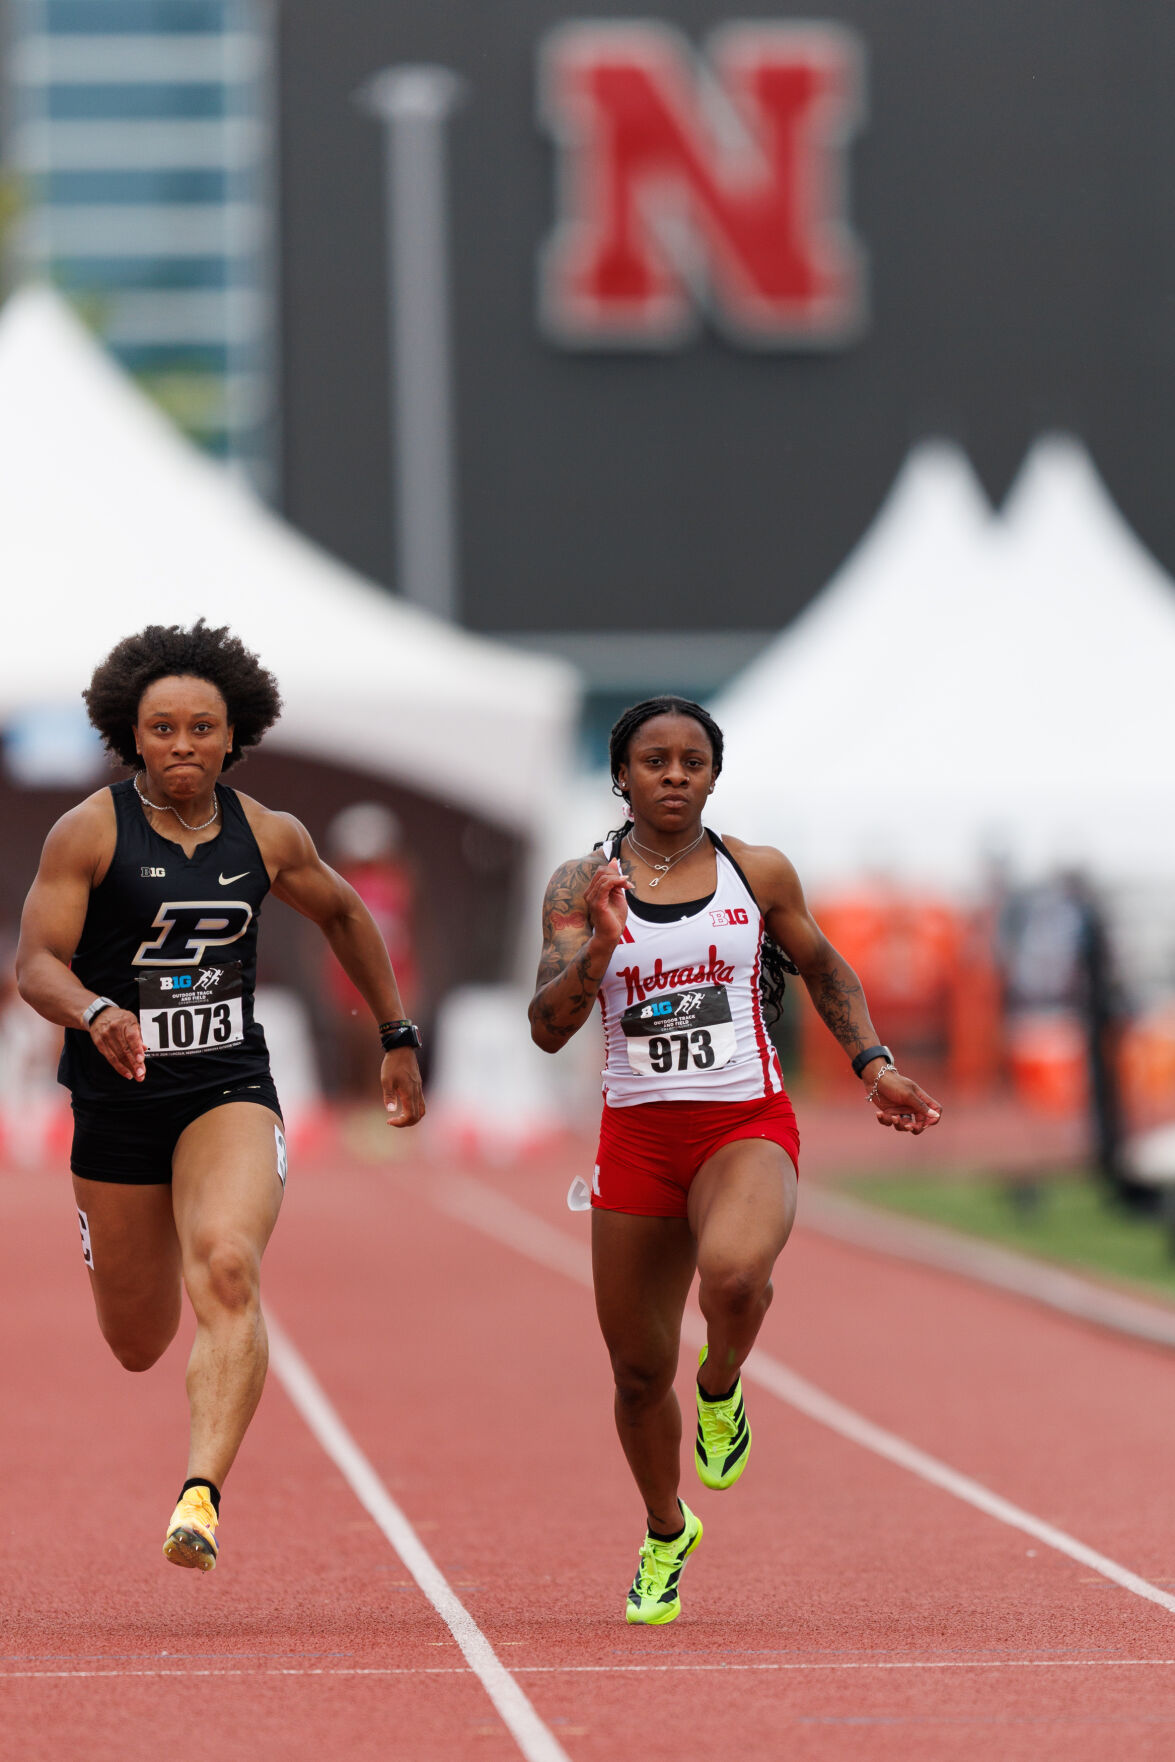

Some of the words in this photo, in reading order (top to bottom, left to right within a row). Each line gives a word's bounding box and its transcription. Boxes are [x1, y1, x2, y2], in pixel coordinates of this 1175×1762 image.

[538, 21, 867, 346] N
[131, 901, 253, 966] P
[616, 944, 736, 1006] Nebraska
[152, 1003, 232, 1049] 1073
[649, 1029, 715, 1073] 973
